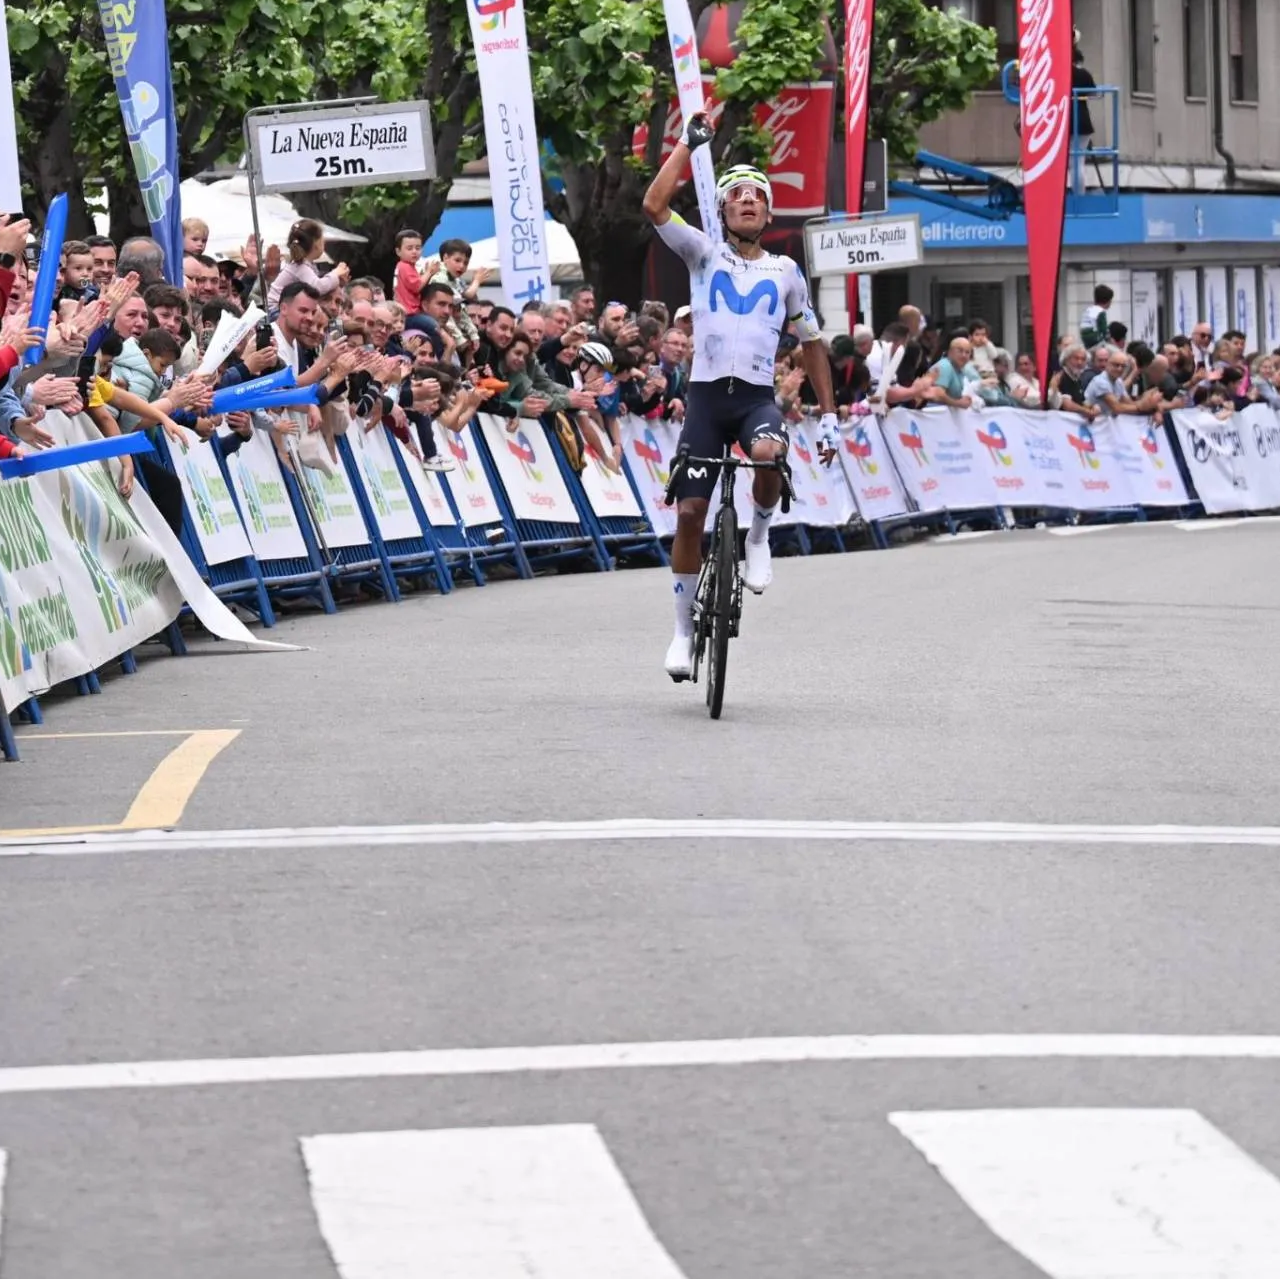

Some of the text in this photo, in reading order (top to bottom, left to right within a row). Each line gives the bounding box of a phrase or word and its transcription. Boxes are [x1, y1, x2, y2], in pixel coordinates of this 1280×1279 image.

[271, 121, 407, 154] La Nueva España
[314, 156, 373, 177] 25m.
[820, 227, 906, 250] La Nueva España
[847, 248, 884, 264] 50m.
